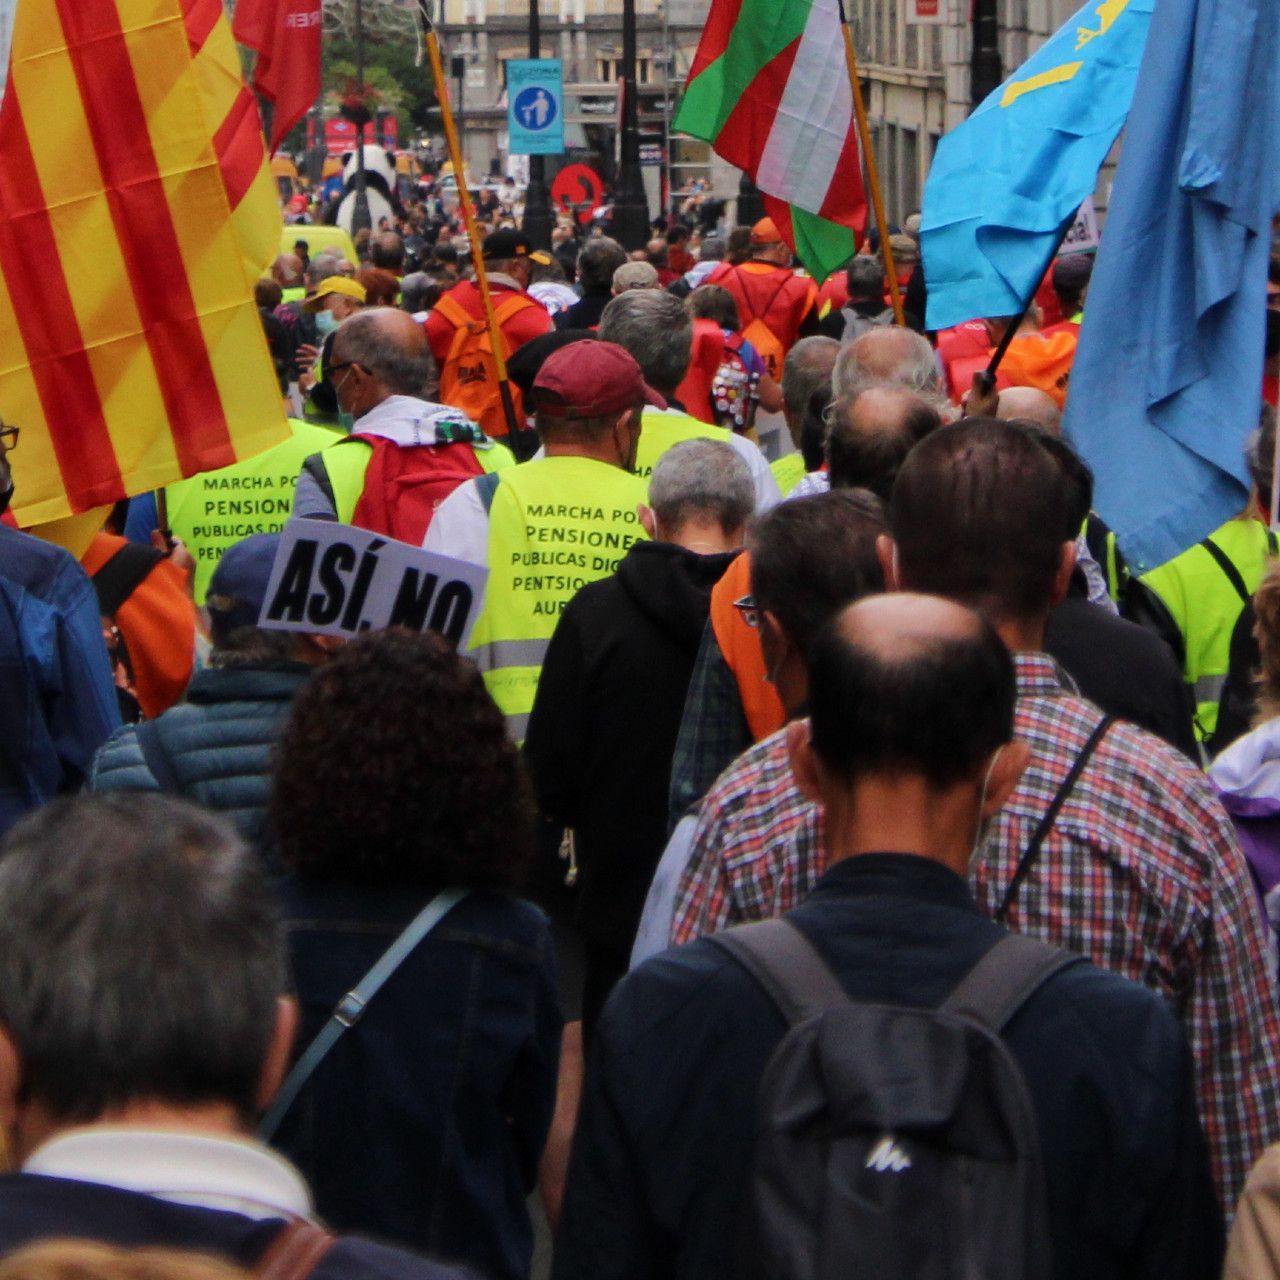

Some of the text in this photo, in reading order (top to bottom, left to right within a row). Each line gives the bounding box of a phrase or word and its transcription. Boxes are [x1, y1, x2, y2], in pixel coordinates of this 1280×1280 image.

[204, 476, 299, 491] MARCHA PO
[205, 498, 290, 516] PENSION
[527, 505, 641, 525] MARCHA PO
[192, 523, 264, 539] PUBLICAS
[511, 552, 586, 568] PUBLICAS
[512, 575, 587, 591] PENTSIO
[388, 566, 474, 652] NO
